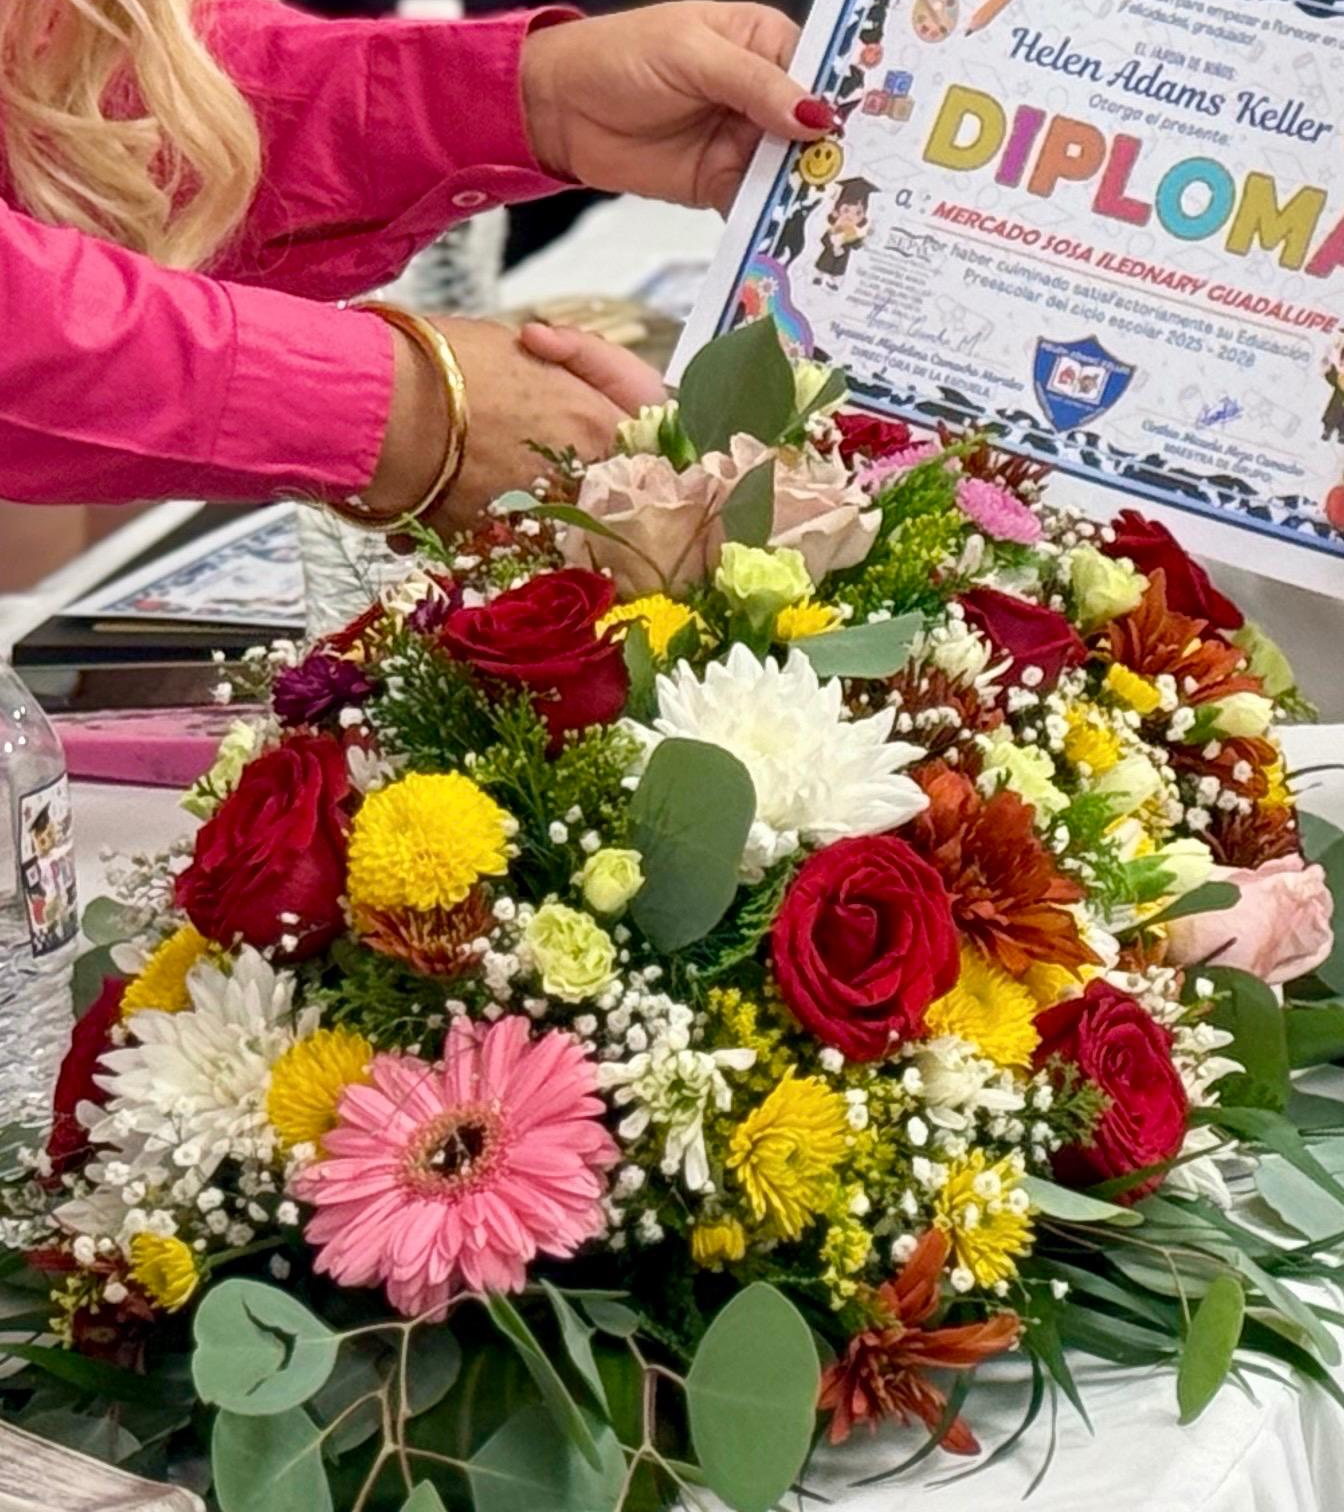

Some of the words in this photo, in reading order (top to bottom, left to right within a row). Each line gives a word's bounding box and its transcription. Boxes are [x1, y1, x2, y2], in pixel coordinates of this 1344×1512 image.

[1207, 2, 1261, 27] empezar
[1272, 18, 1321, 44] florecer
[1322, 37, 1338, 48] en
[1134, 41, 1148, 55] EL
[1186, 54, 1201, 70] DE
[1010, 26, 1103, 82] Helen
[1107, 59, 1226, 116] Adams
[1236, 90, 1334, 145] Keller
[1088, 93, 1143, 121] Otorga
[1145, 111, 1160, 125] el
[931, 201, 1043, 246] MERCADO
[1040, 235, 1095, 264] SOSA
[1095, 251, 1210, 295] ILEDNARY
[1207, 285, 1341, 335] GUADALUPE
[922, 235, 947, 253] Por
[950, 243, 994, 266] haber
[995, 259, 1070, 290] culminado
[1072, 284, 1213, 334] satisfactoriamente
[1216, 325, 1234, 339] su
[1236, 329, 1311, 363] Educación
[963, 267, 1042, 303] Preescolar
[1045, 291, 1068, 311] del
[1069, 301, 1106, 323] ciclo
[1107, 312, 1164, 340] escolar
[1164, 329, 1204, 354] 2025
[851, 345, 911, 372] DIRECTORA
[911, 365, 927, 377] DE
[927, 368, 942, 381] LA
[1217, 457, 1231, 469] DE
